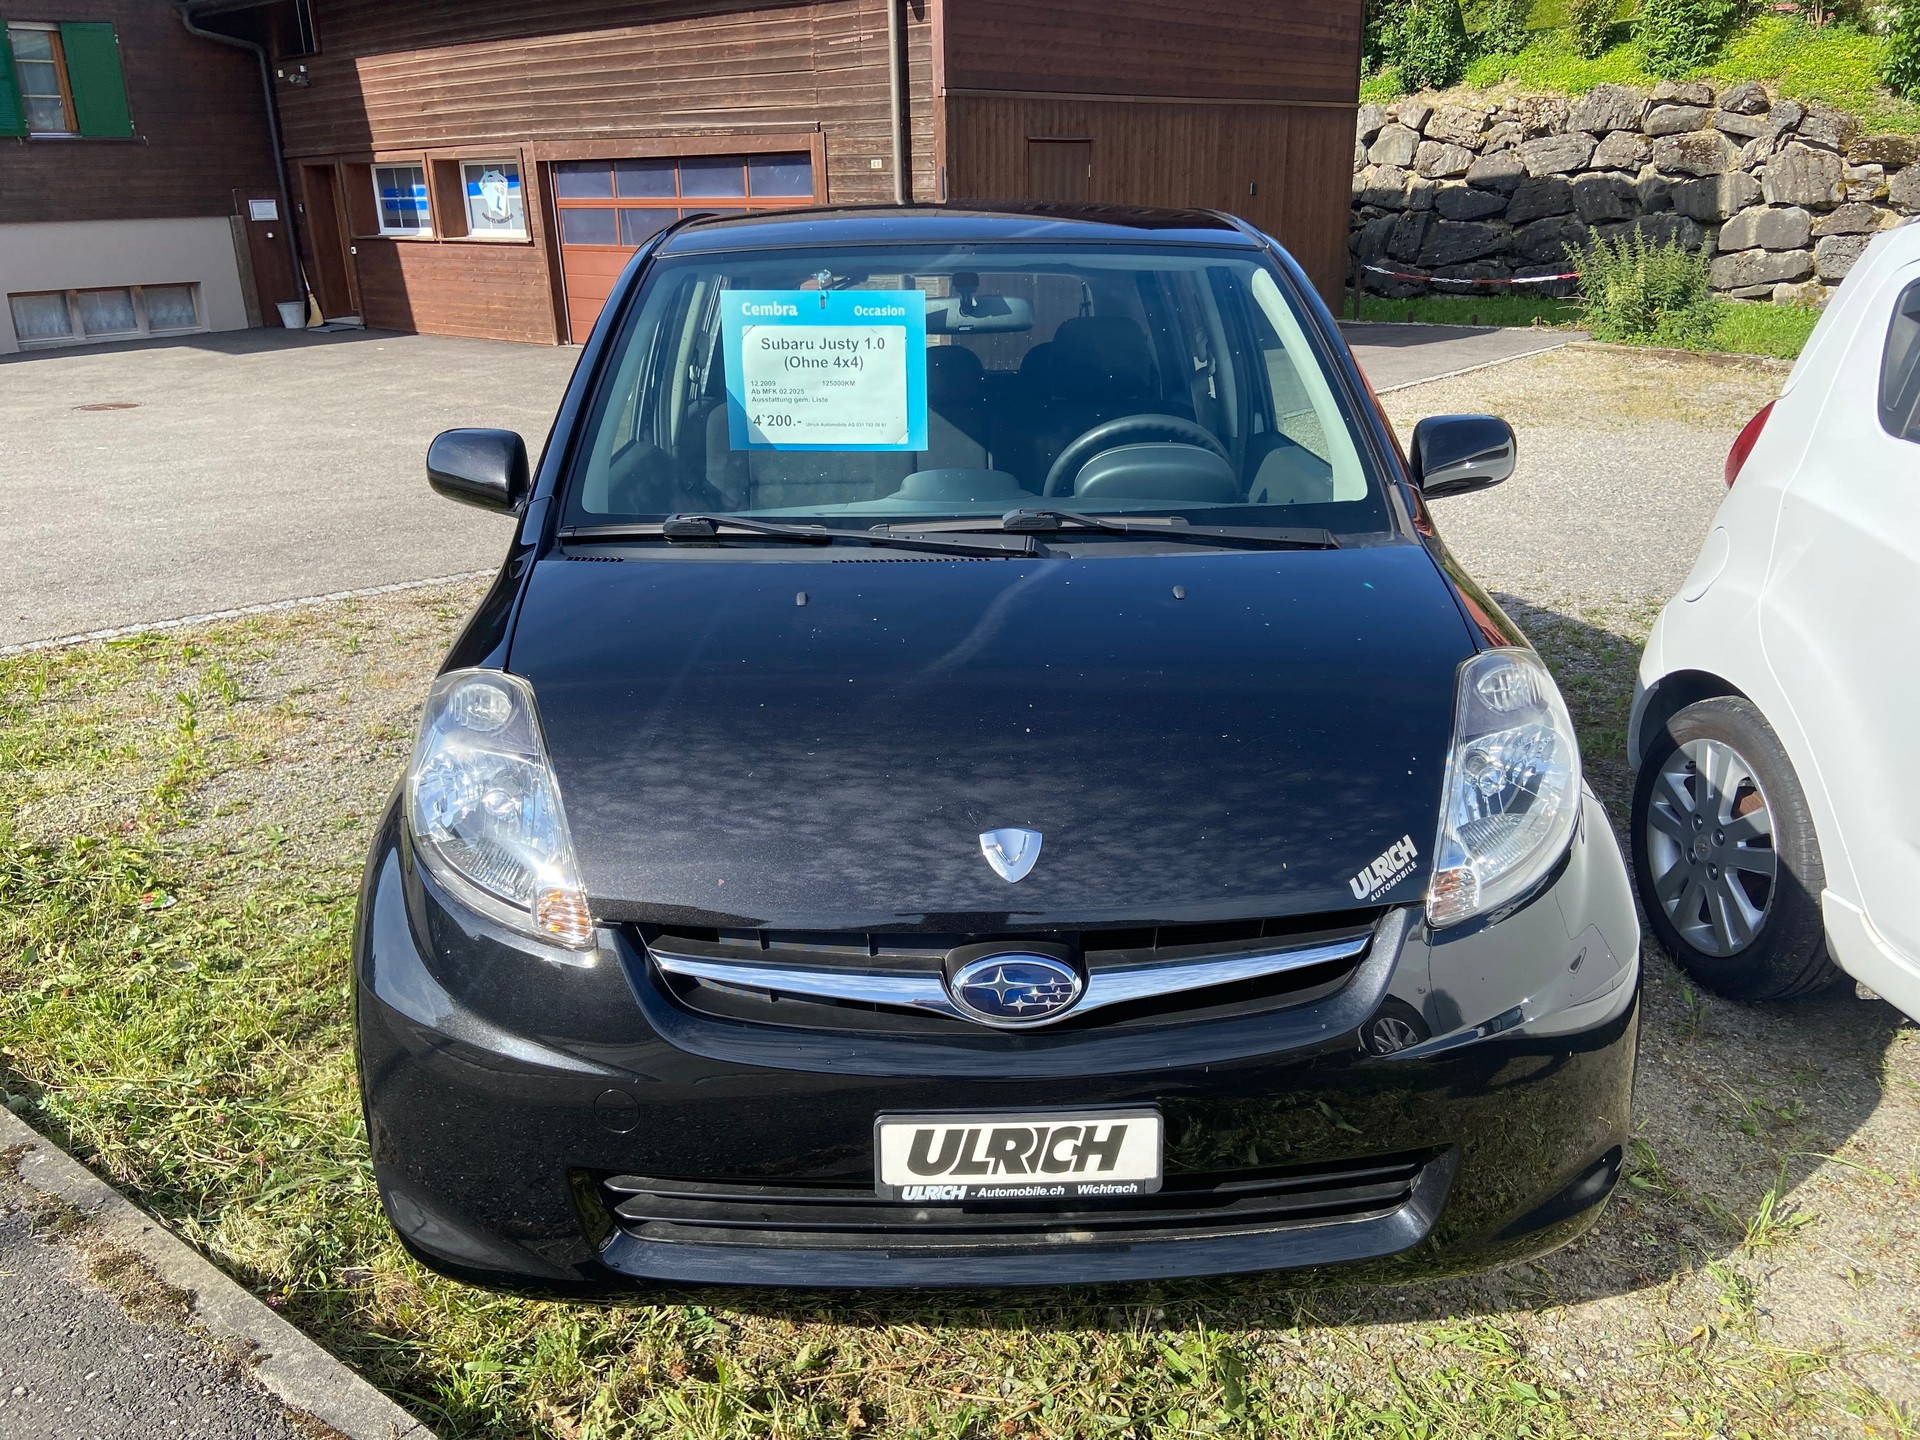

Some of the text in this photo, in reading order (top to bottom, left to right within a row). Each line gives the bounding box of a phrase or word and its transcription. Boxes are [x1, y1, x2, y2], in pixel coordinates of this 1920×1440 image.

[741, 302, 798, 317] Cembra
[854, 305, 905, 317] Occasion
[761, 337, 885, 352] Subaru Justy 1.0
[784, 356, 864, 371] (Ohne 4x4)
[752, 396, 793, 404] Ausstattung
[1349, 834, 1418, 900] ULRICH
[1370, 861, 1418, 902] AUTOMOBILE
[907, 1125, 1128, 1176] ULRICH
[901, 1185, 967, 1200] ULRICH
[977, 1185, 1066, 1198] Automobile.ch
[1077, 1183, 1139, 1195] Wichtrach
